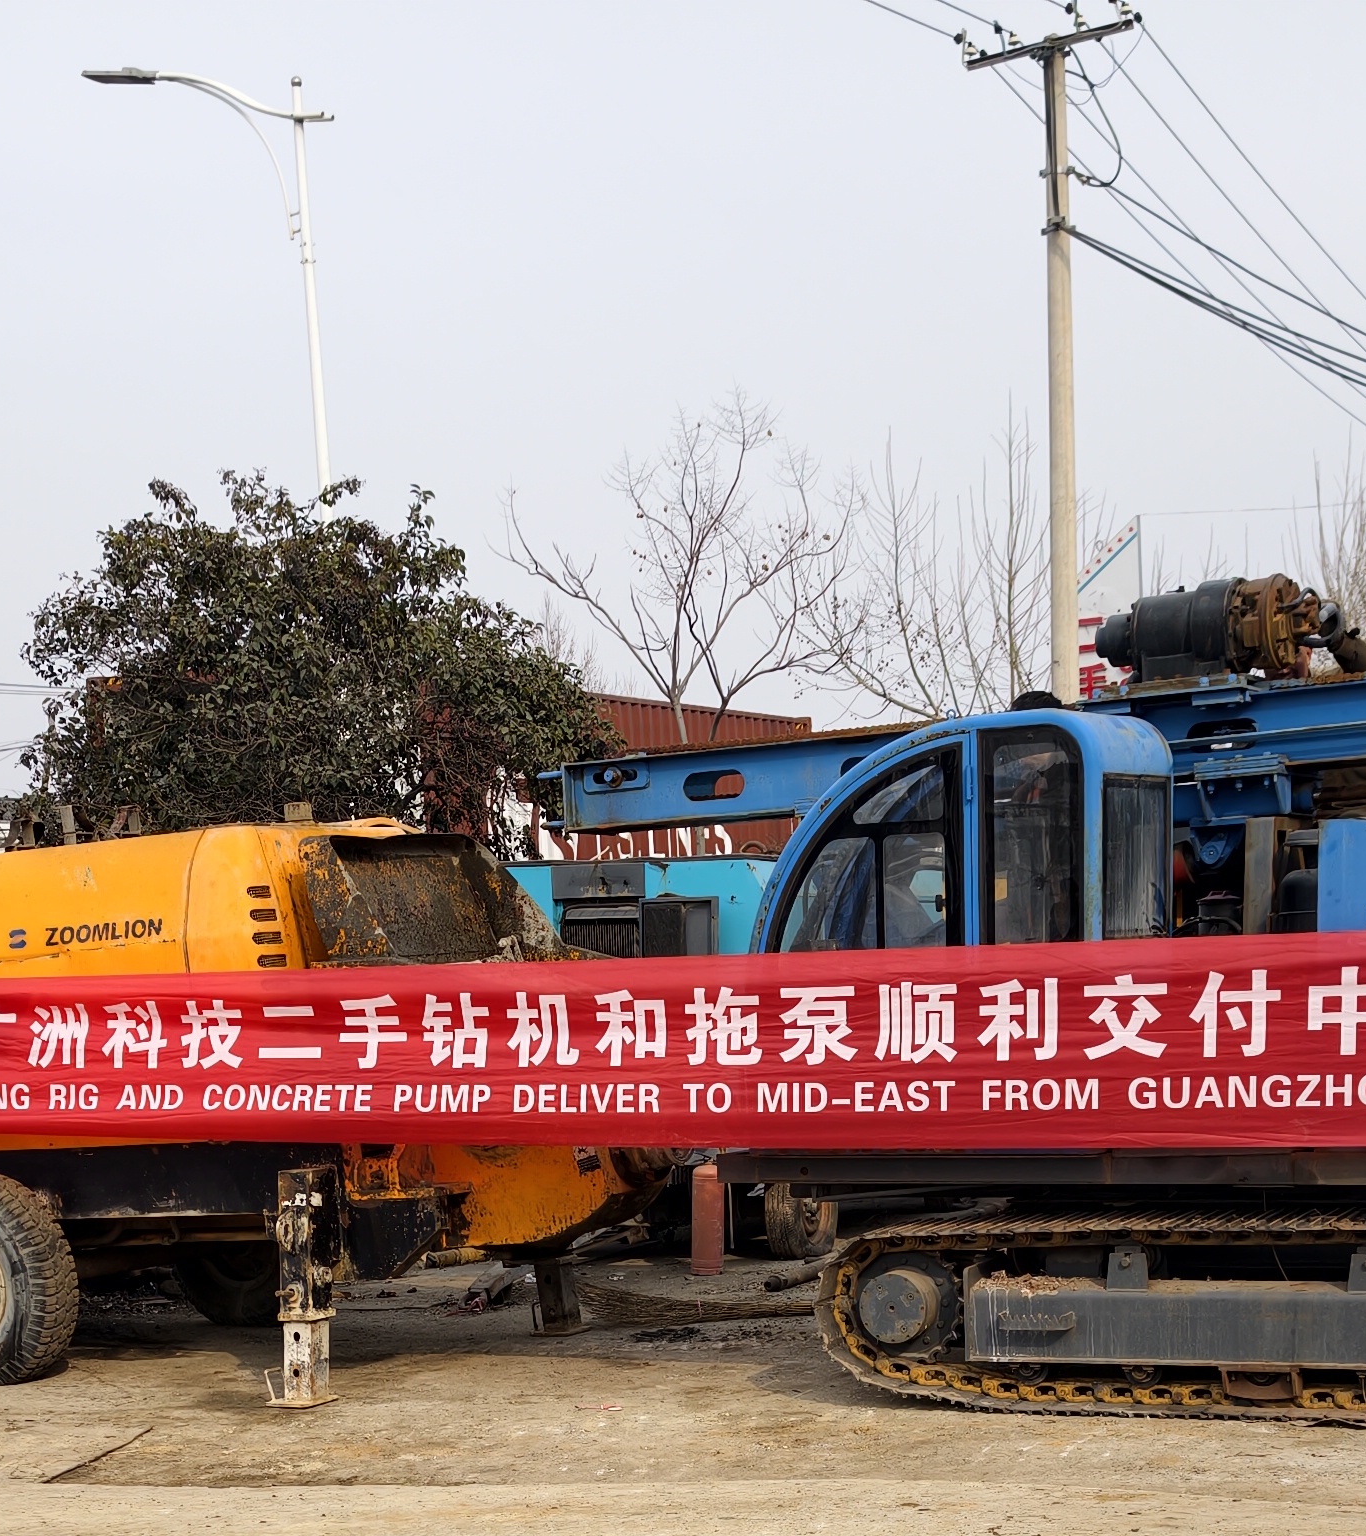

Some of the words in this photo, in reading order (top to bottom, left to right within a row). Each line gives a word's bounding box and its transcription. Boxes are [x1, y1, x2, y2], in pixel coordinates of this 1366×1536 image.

[45, 918, 163, 947] ZOOMLION
[49, 1083, 99, 1110] RIG
[116, 1084, 184, 1110] AND
[202, 1084, 373, 1111] CONCRETE
[394, 1084, 491, 1113] PUMP
[513, 1083, 660, 1113] DELIVER
[682, 1082, 732, 1113] TO
[757, 1080, 956, 1113] MID-EAST
[983, 1078, 1099, 1111] FROM
